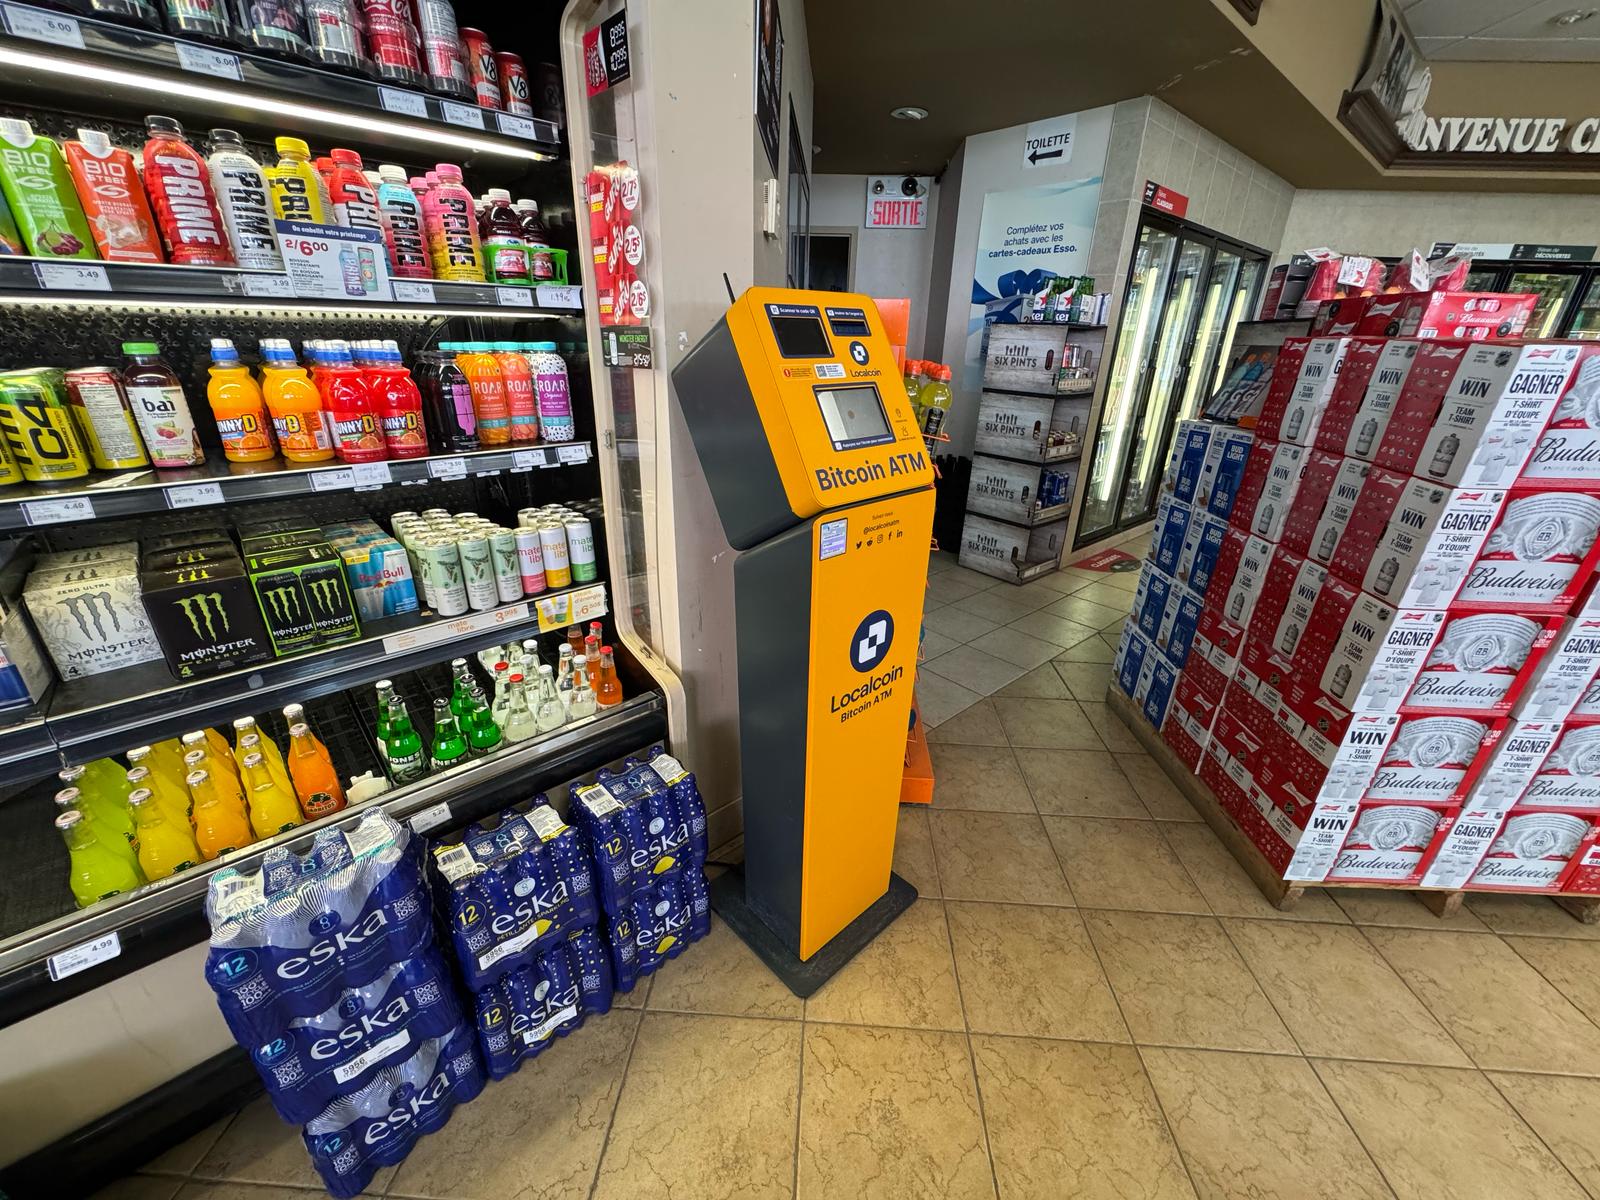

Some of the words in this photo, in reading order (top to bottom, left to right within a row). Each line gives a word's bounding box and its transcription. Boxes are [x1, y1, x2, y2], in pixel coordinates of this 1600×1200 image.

[479, 53, 497, 82] V8
[508, 75, 529, 100] V8
[1026, 132, 1071, 151] TOILETTE
[2, 149, 50, 168] BIO
[83, 159, 126, 177] BIO
[86, 174, 128, 185] STEEL
[155, 155, 221, 246] PRIME
[276, 178, 313, 220] PRI
[343, 184, 382, 230] PRI
[222, 170, 276, 251] PRIME
[872, 201, 923, 226] SORTIE
[388, 200, 426, 267] PRIME
[438, 198, 476, 266] PRIME
[1006, 224, 1048, 236] Complétez
[1050, 222, 1064, 232] vos
[1004, 236, 1028, 247] achats
[1031, 236, 1050, 245] avec
[1052, 234, 1064, 243] les
[988, 246, 1051, 259] cartes-cadeaux
[1053, 244, 1078, 254] Esso.
[78, 270, 99, 278] 3.49
[994, 356, 1008, 366] SIX
[1010, 356, 1038, 368] PINTS
[850, 368, 882, 378] Localcoin
[1305, 364, 1322, 378] WIN
[1379, 370, 1402, 385] WIN
[474, 382, 503, 394] ROAR
[538, 380, 566, 392] ROAR
[1459, 380, 1490, 398] WIN
[1510, 374, 1564, 394] GAGNER
[142, 398, 176, 412] bai
[1456, 406, 1474, 415] TEAM
[1512, 400, 1542, 408] T-SHIRT
[1449, 414, 1476, 425] T-SHIRT
[1504, 410, 1540, 419] D'ÉQUIPE
[14, 395, 70, 459] C4
[984, 422, 998, 433] SIX
[1000, 425, 1026, 436] PINTS
[1226, 452, 1244, 461] LIGHT
[815, 460, 886, 492] Bitcoin
[888, 451, 927, 477] ATM
[1273, 466, 1290, 480] WIN
[976, 484, 989, 493] SIX
[991, 486, 1014, 500] PINTS
[1338, 484, 1358, 500] WIN
[1400, 508, 1427, 530] WIN
[1441, 513, 1492, 532] GAGNER
[571, 536, 593, 545] mate
[1396, 533, 1412, 542] TEAM
[1444, 535, 1474, 544] T-SHIRT
[518, 547, 542, 556] mate
[543, 542, 566, 551] mate
[968, 541, 980, 550] SIX
[982, 545, 1004, 558] PINTS
[1438, 543, 1470, 552] D'ÉQUIPE
[1244, 557, 1259, 572] WIN
[359, 572, 382, 583] Red
[382, 566, 404, 579] Bull
[1467, 566, 1568, 592] Budweiser
[56, 588, 81, 596] ZERO
[83, 582, 110, 590] ULTRA
[1298, 584, 1317, 602] WIN
[272, 620, 314, 637] MONSTER
[448, 620, 468, 630] mate
[457, 625, 475, 634] libre
[1351, 620, 1375, 642] WIN
[1388, 630, 1434, 647] GAGNER
[1564, 638, 1600, 653] GAGNE
[68, 637, 150, 661] MONSTER
[181, 638, 256, 662] MONSTER
[1392, 650, 1417, 658] T-SHIRT
[68, 666, 79, 676] 4
[180, 666, 194, 676] 4
[830, 665, 904, 714] Localcoin
[1414, 676, 1507, 698] Budweiser
[841, 700, 872, 722] Bitcoin
[873, 688, 893, 705] ATM
[1350, 730, 1388, 746] WIN
[1506, 739, 1550, 754] GAGNER
[1354, 749, 1372, 757] TEAM
[1373, 772, 1458, 791] Budweiser
[1528, 780, 1600, 797] Budweis
[1313, 818, 1348, 831] WIN
[1454, 824, 1496, 839] GAGNER
[606, 838, 622, 854] 12
[630, 823, 688, 868] eska
[1336, 854, 1418, 872] Budweiser
[1477, 862, 1560, 880] Budweiser
[492, 880, 568, 934] eska
[458, 906, 479, 926] 12
[496, 917, 536, 942] PÉTILLANTE
[537, 899, 570, 918] SPARKLING
[617, 922, 630, 937] 12
[636, 904, 691, 948] eska
[91, 938, 113, 952] 4.99
[276, 906, 388, 980] eska
[222, 956, 248, 976] 12
[484, 1008, 502, 1026] 12
[510, 984, 580, 1034] eska
[310, 996, 410, 1060] eska
[260, 1037, 285, 1056] 12
[342, 1056, 366, 1076] 5956
[364, 1072, 450, 1145] eska
[324, 1136, 343, 1153] 12
